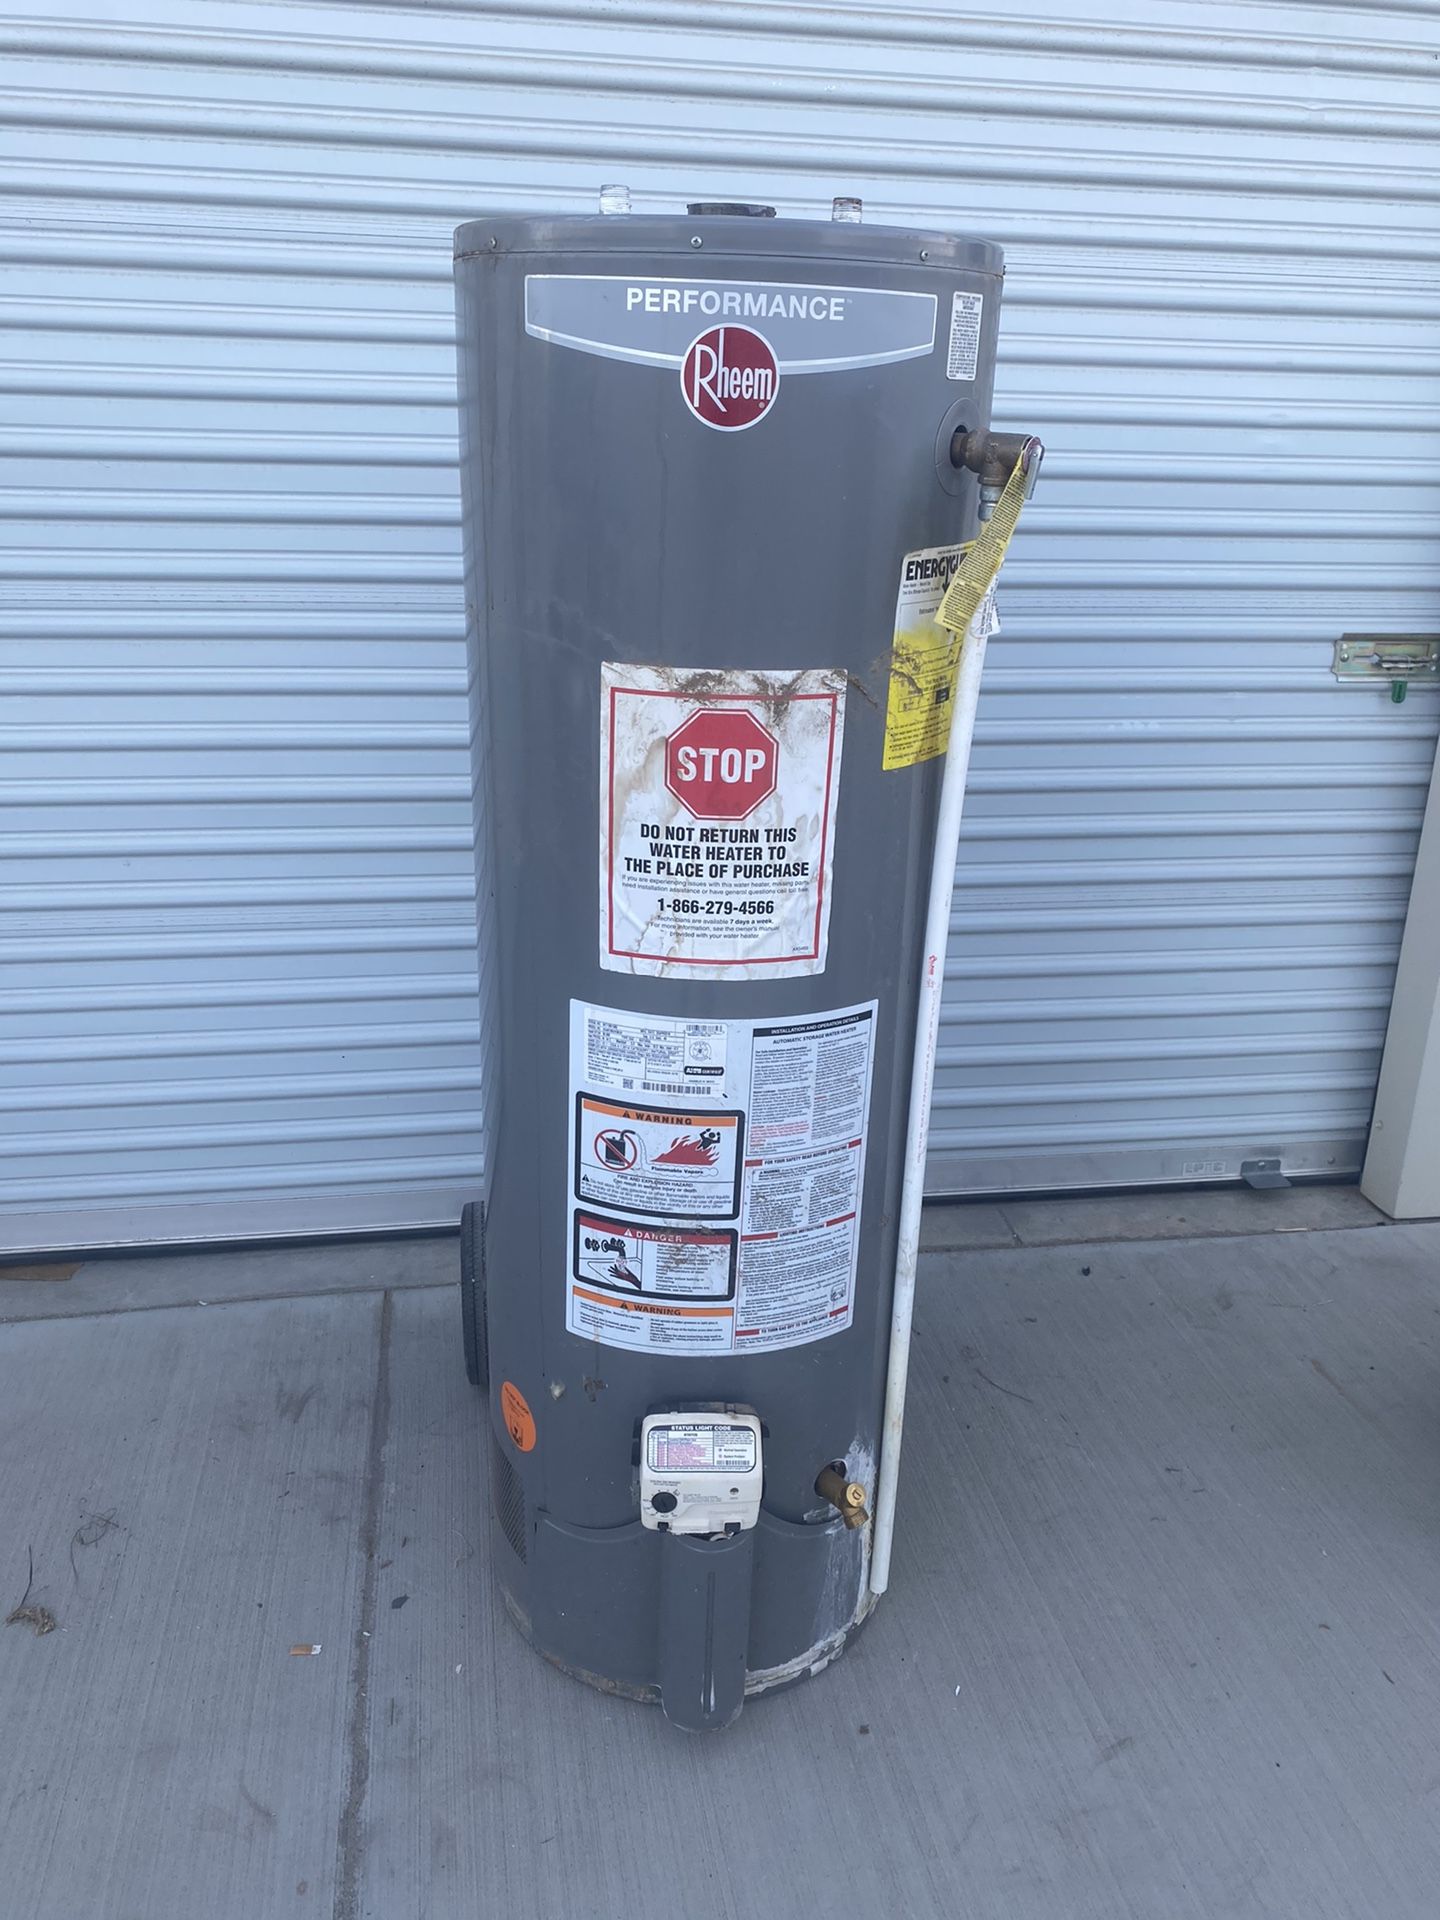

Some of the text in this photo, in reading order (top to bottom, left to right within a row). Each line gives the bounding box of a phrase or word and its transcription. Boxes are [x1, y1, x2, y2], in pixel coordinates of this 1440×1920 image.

[626, 287, 845, 321] PERFORMANCE
[693, 328, 772, 412] Rheem
[677, 746, 766, 784] STOP
[641, 824, 796, 844] DO NOT RETURN THIS
[650, 842, 786, 861] WATER HEATER TO
[624, 857, 809, 879] THE PLACE OF PURCHASE
[638, 883, 668, 891] installation
[650, 878, 686, 887] experiencing
[658, 898, 774, 915] 1-866-279-4566
[771, 1026, 806, 1034] INSTALLATION
[817, 1020, 842, 1029] OPERATION
[825, 1030, 840, 1038] WATER
[636, 1112, 692, 1125] WARNING
[636, 1231, 682, 1242] DANGER
[634, 1304, 681, 1316] WARNING
